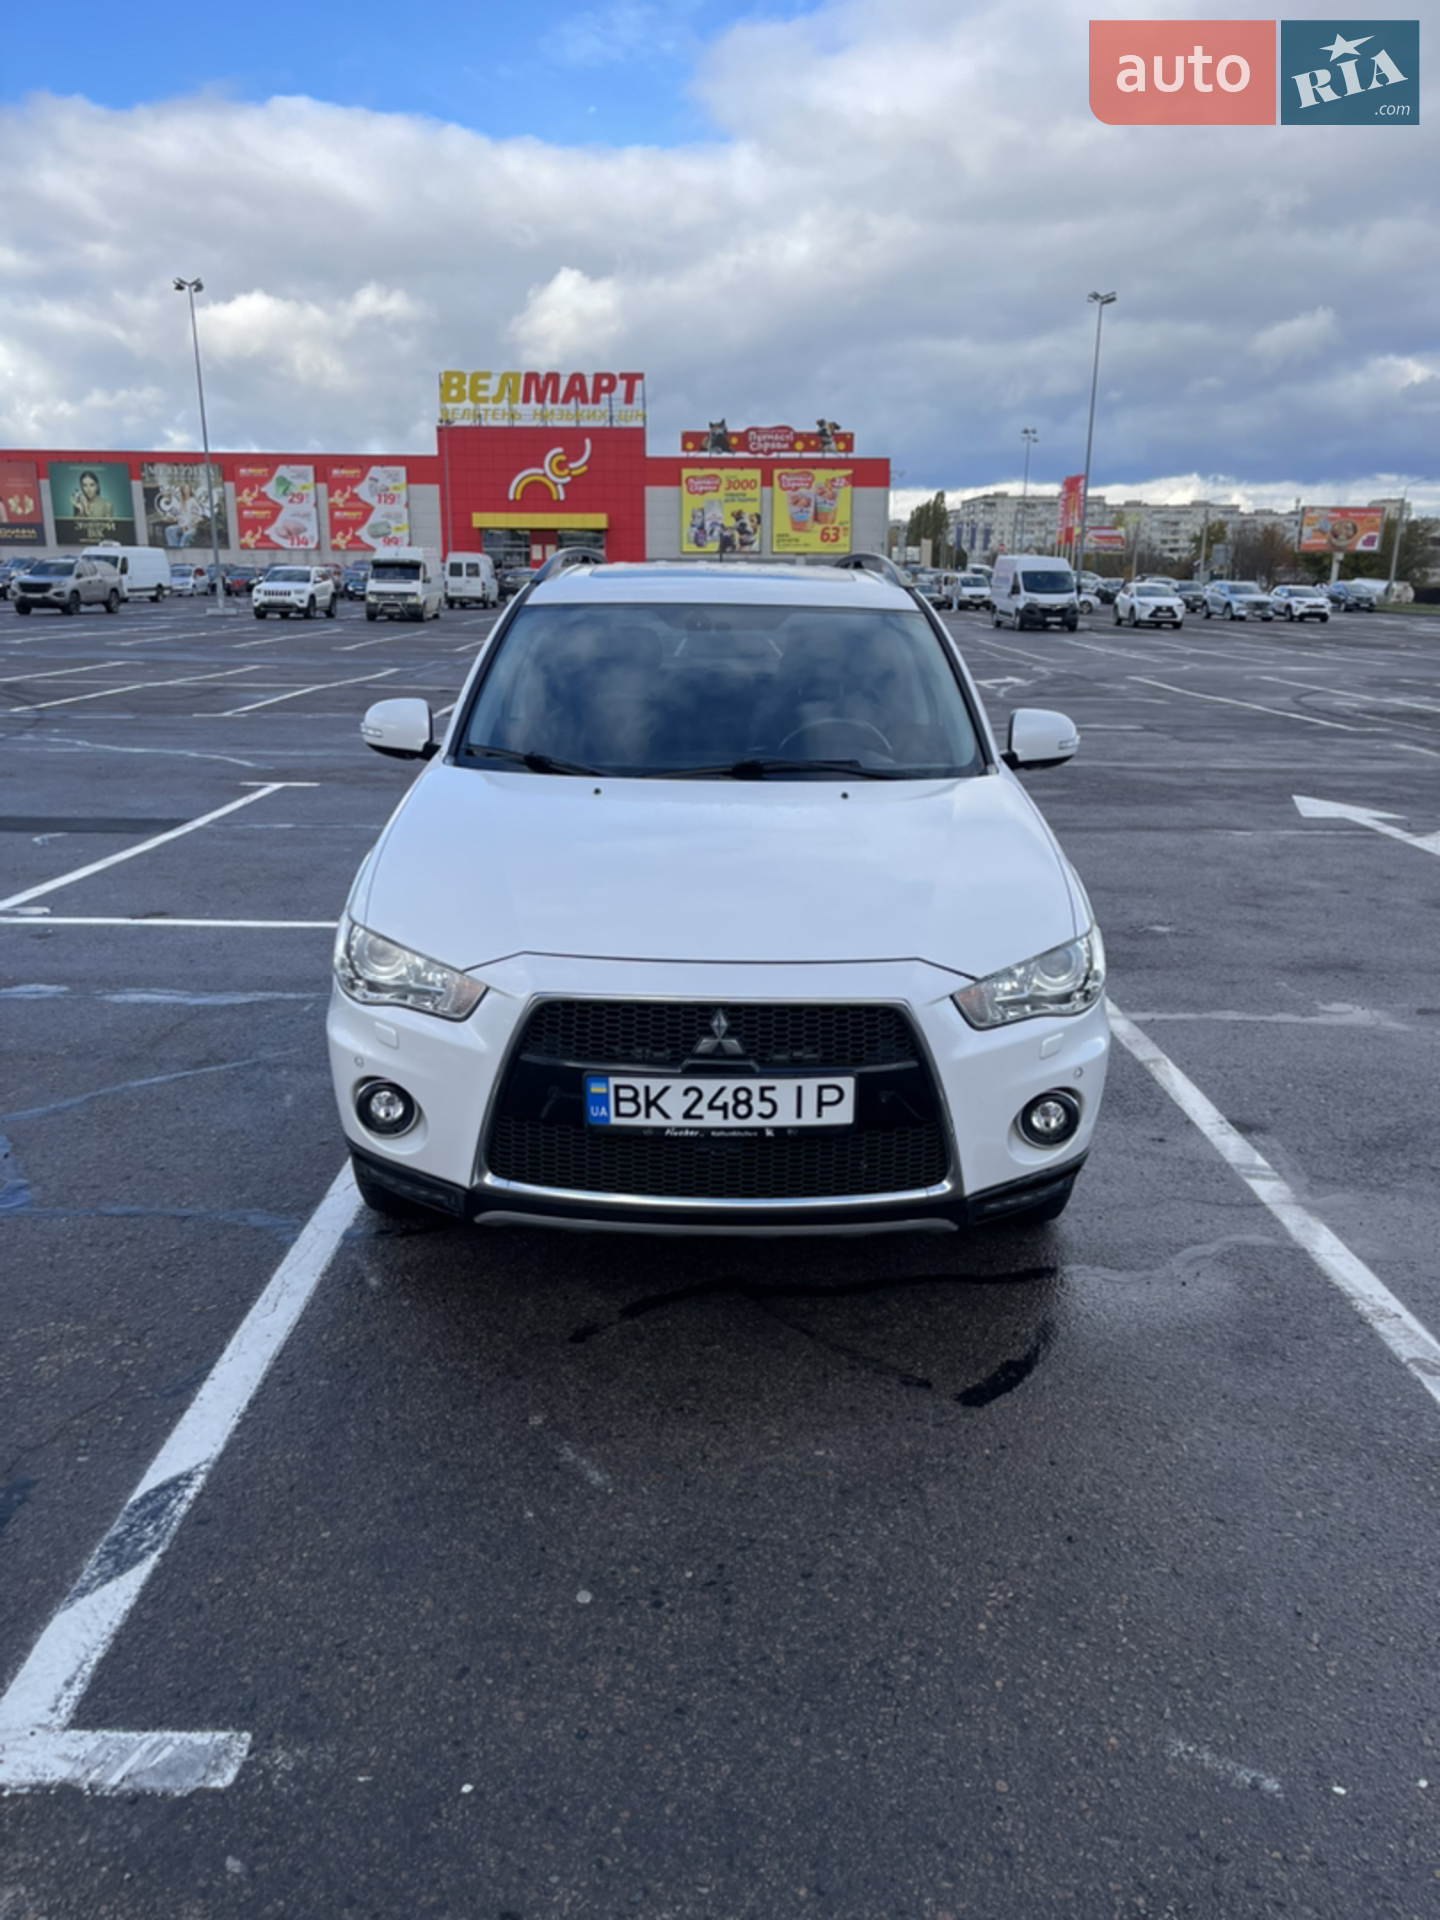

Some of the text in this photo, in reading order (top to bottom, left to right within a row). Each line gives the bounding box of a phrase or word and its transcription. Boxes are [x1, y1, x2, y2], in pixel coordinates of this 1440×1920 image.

[441, 371, 644, 405] ВЕЛМАРТ
[441, 408, 646, 423] ВЕЛЕТЕНЬ НИЗЬКИХ ЦІН
[725, 479, 758, 491] 3000
[288, 493, 305, 505] 29
[376, 493, 396, 505] 119
[820, 526, 841, 543] 63
[613, 1084, 845, 1120] BK 2485 IP
[590, 1106, 608, 1117] UA
